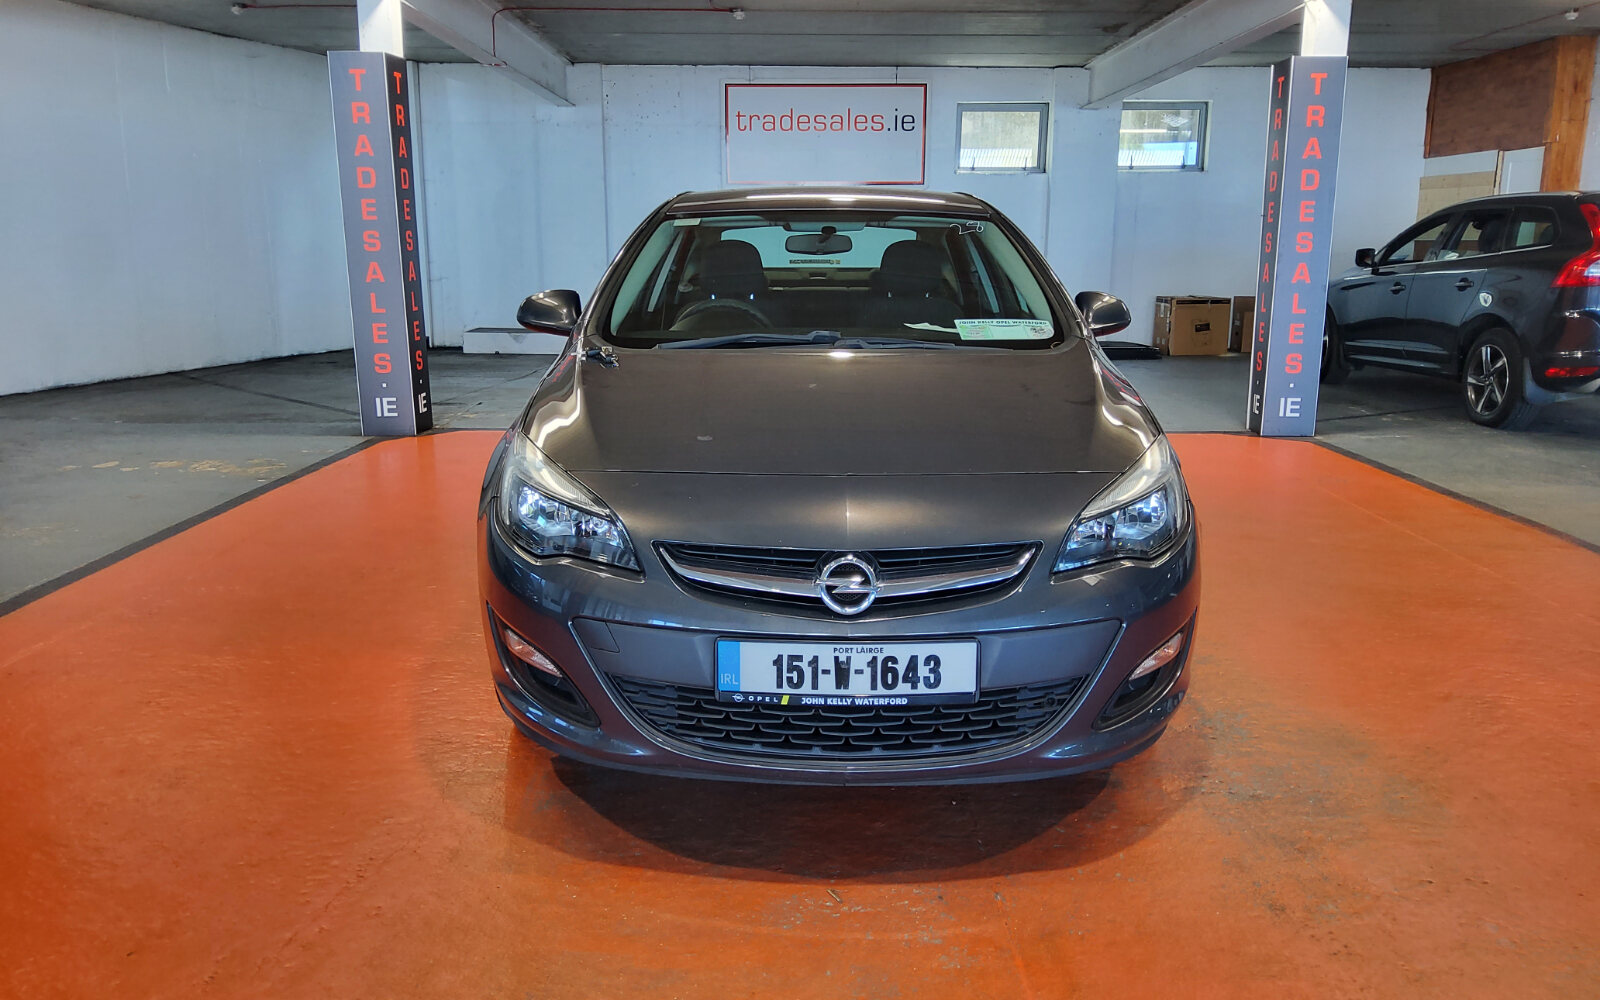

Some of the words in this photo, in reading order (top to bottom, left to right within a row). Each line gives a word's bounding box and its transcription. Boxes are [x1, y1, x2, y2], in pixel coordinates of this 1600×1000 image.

[735, 107, 916, 132] tradesales.ie
[720, 673, 739, 685] IRL
[772, 654, 942, 691] 151-W-1643
[801, 697, 825, 705] JOHN
[826, 697, 853, 705] KELLY
[854, 697, 908, 705] WATERFORD
